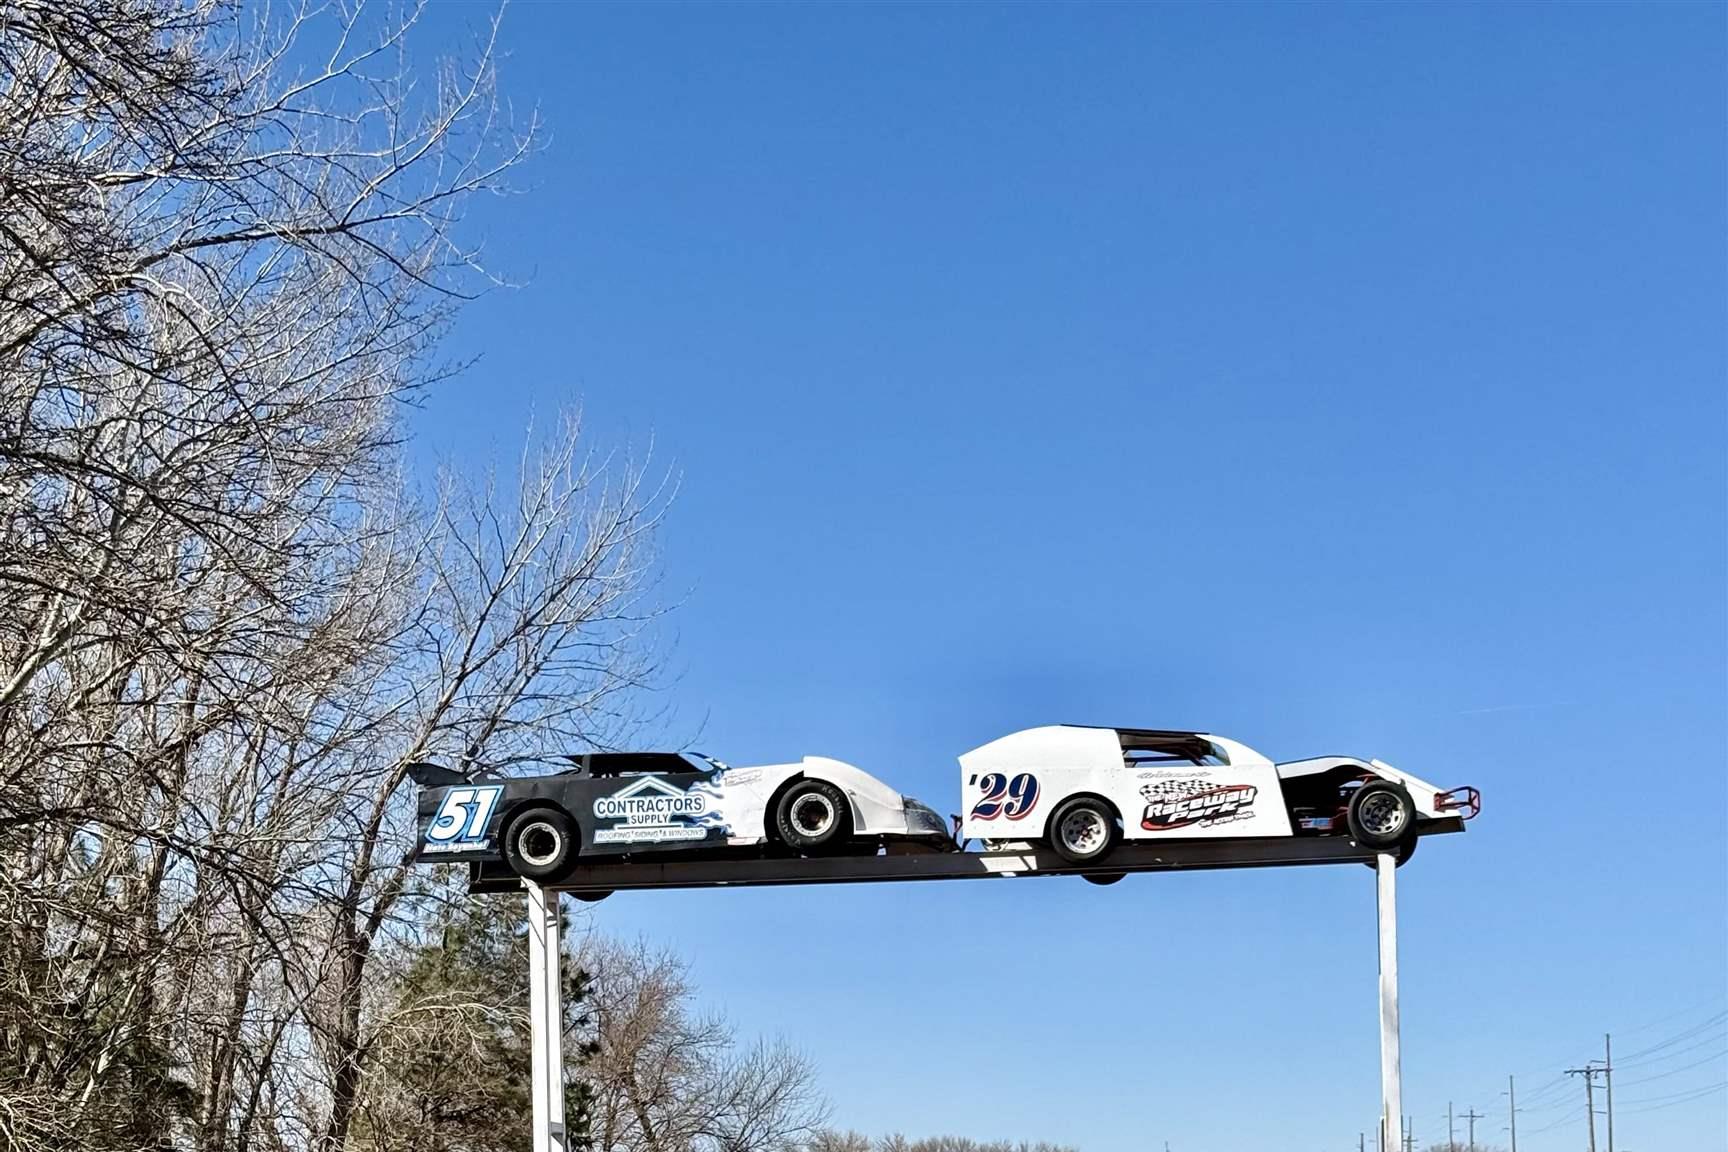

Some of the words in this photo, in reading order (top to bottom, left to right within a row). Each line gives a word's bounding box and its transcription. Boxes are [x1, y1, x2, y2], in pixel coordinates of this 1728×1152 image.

[426, 786, 502, 842] 51
[597, 797, 702, 815] CONTRACTORS
[1146, 787, 1255, 819] Raceway
[1167, 801, 1240, 823] Park
[631, 813, 670, 825] SUPPLY
